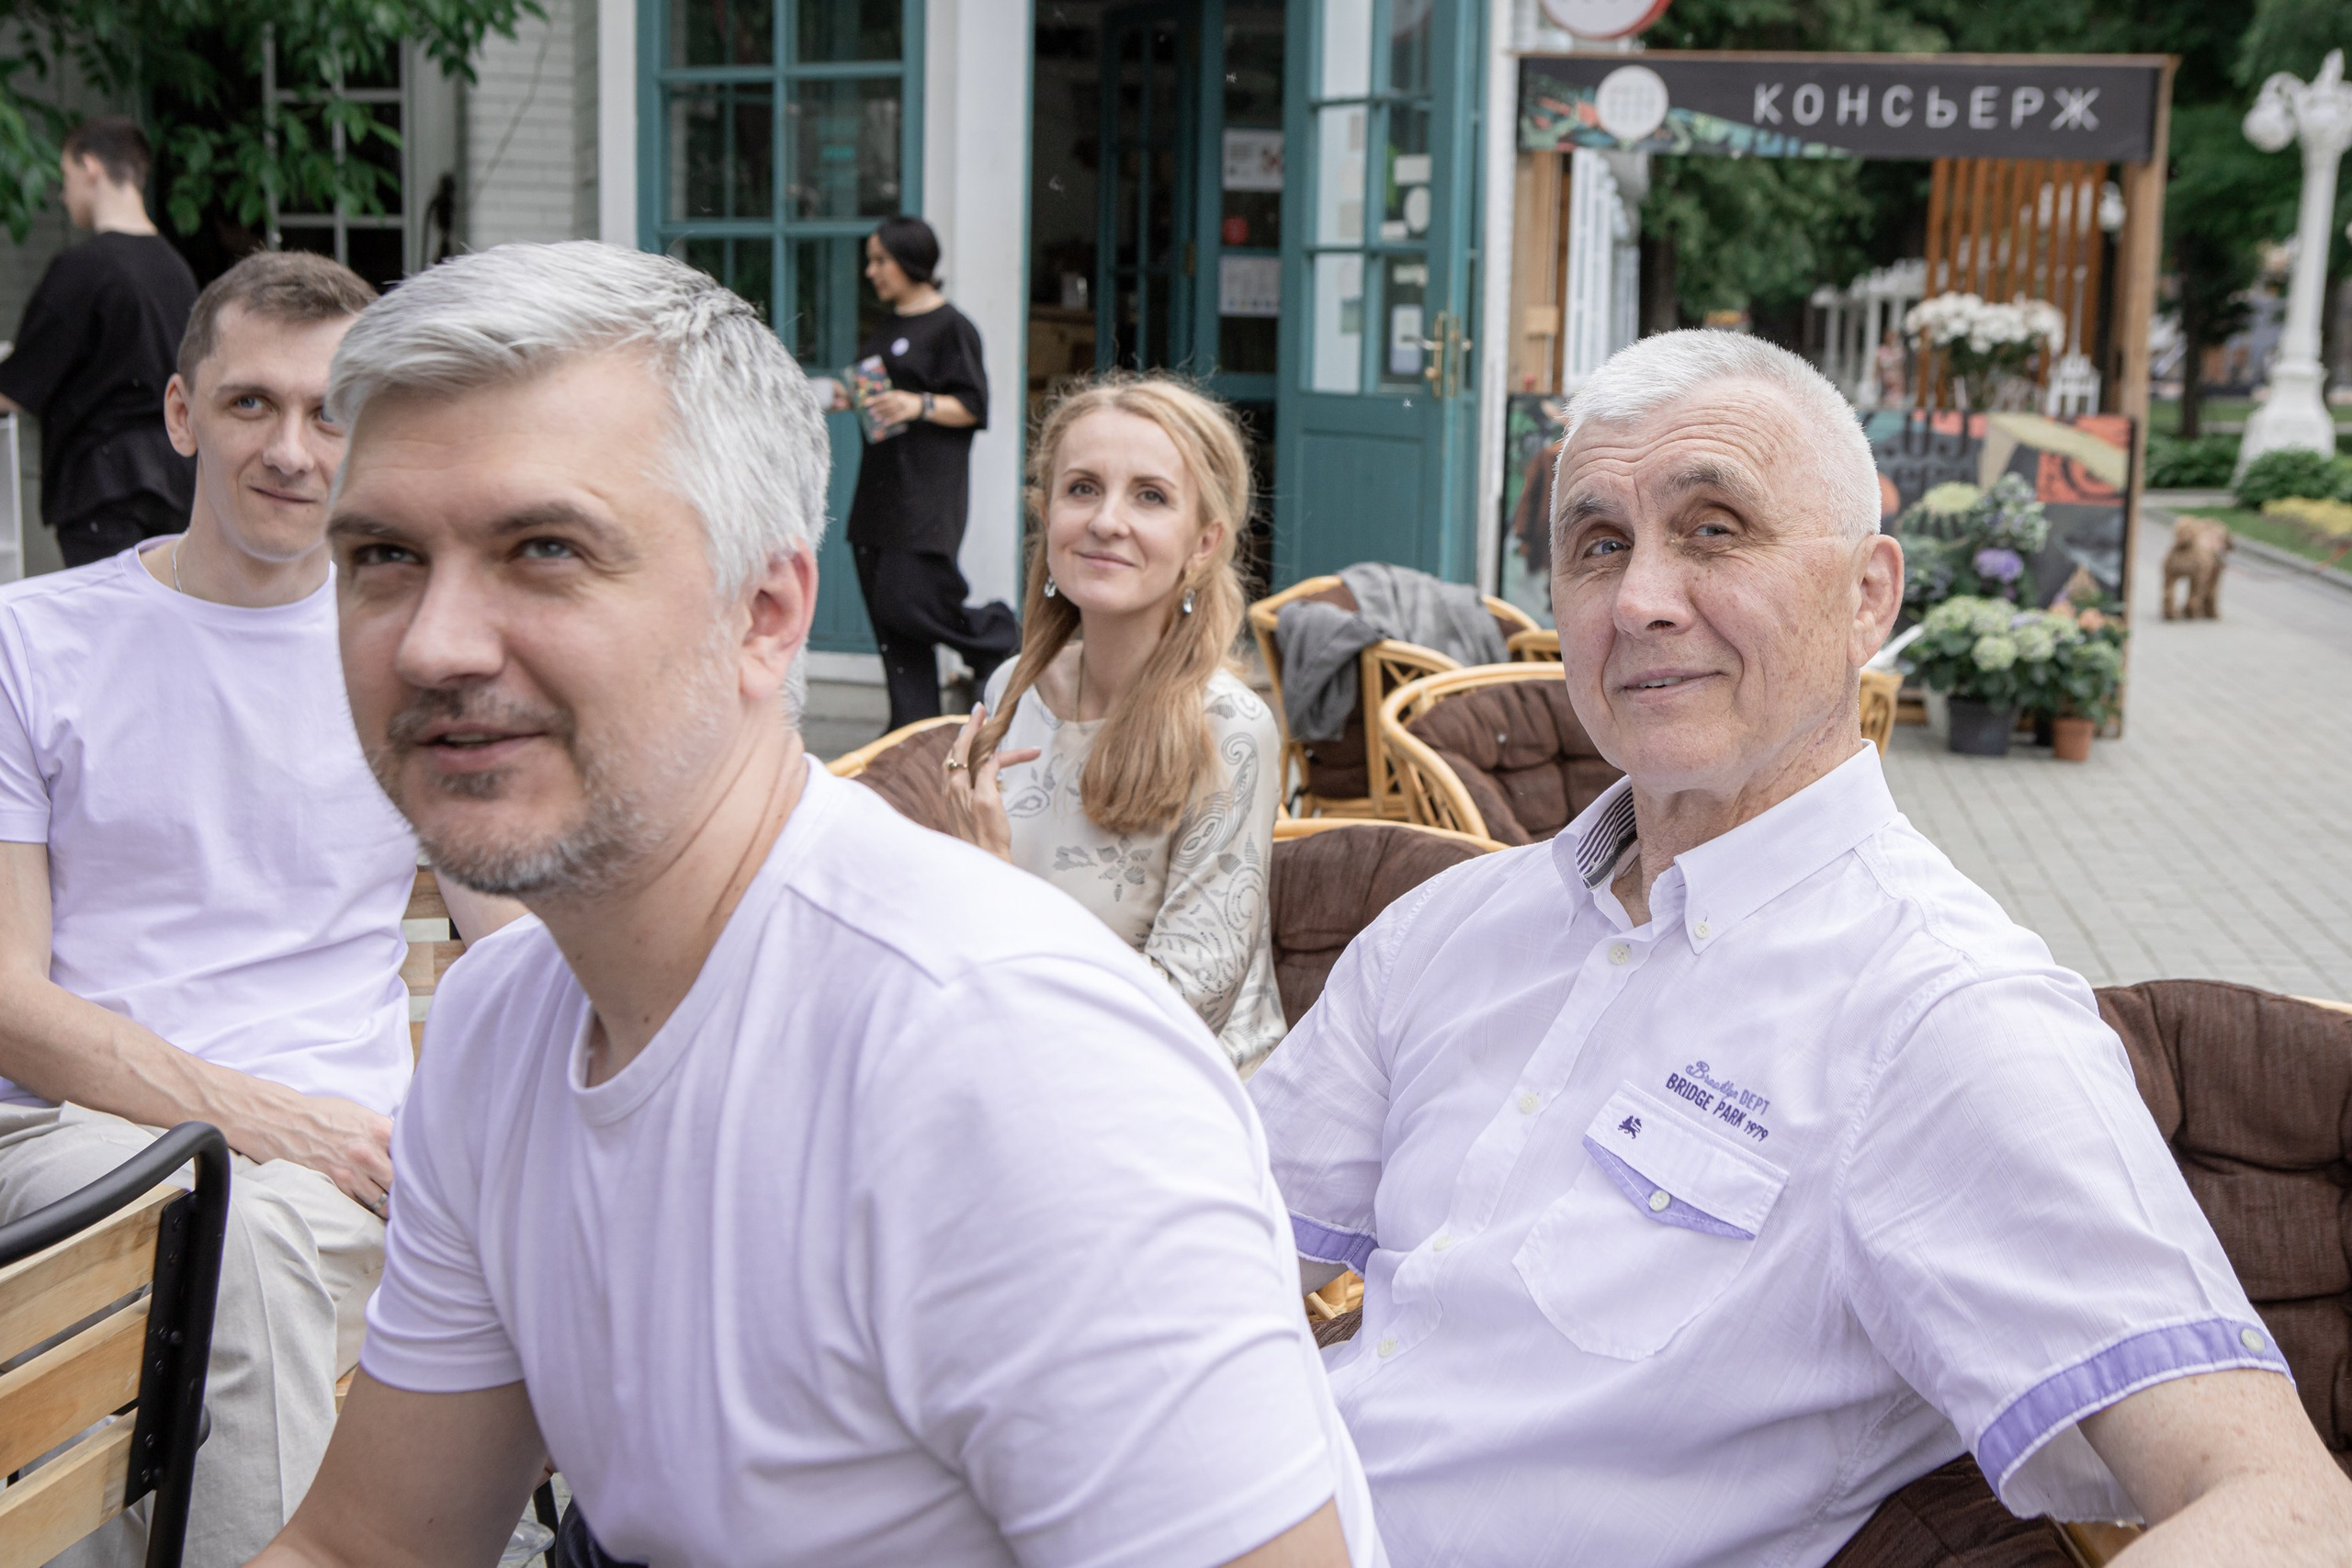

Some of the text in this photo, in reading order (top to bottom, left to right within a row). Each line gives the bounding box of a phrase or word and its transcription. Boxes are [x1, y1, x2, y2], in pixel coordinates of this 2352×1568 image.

[1752, 82, 2101, 131] КОНСЬЕРЖ
[1666, 1072, 1769, 1143] BRIDGE PARK 1979
[1739, 1089, 1770, 1116] DEPT
